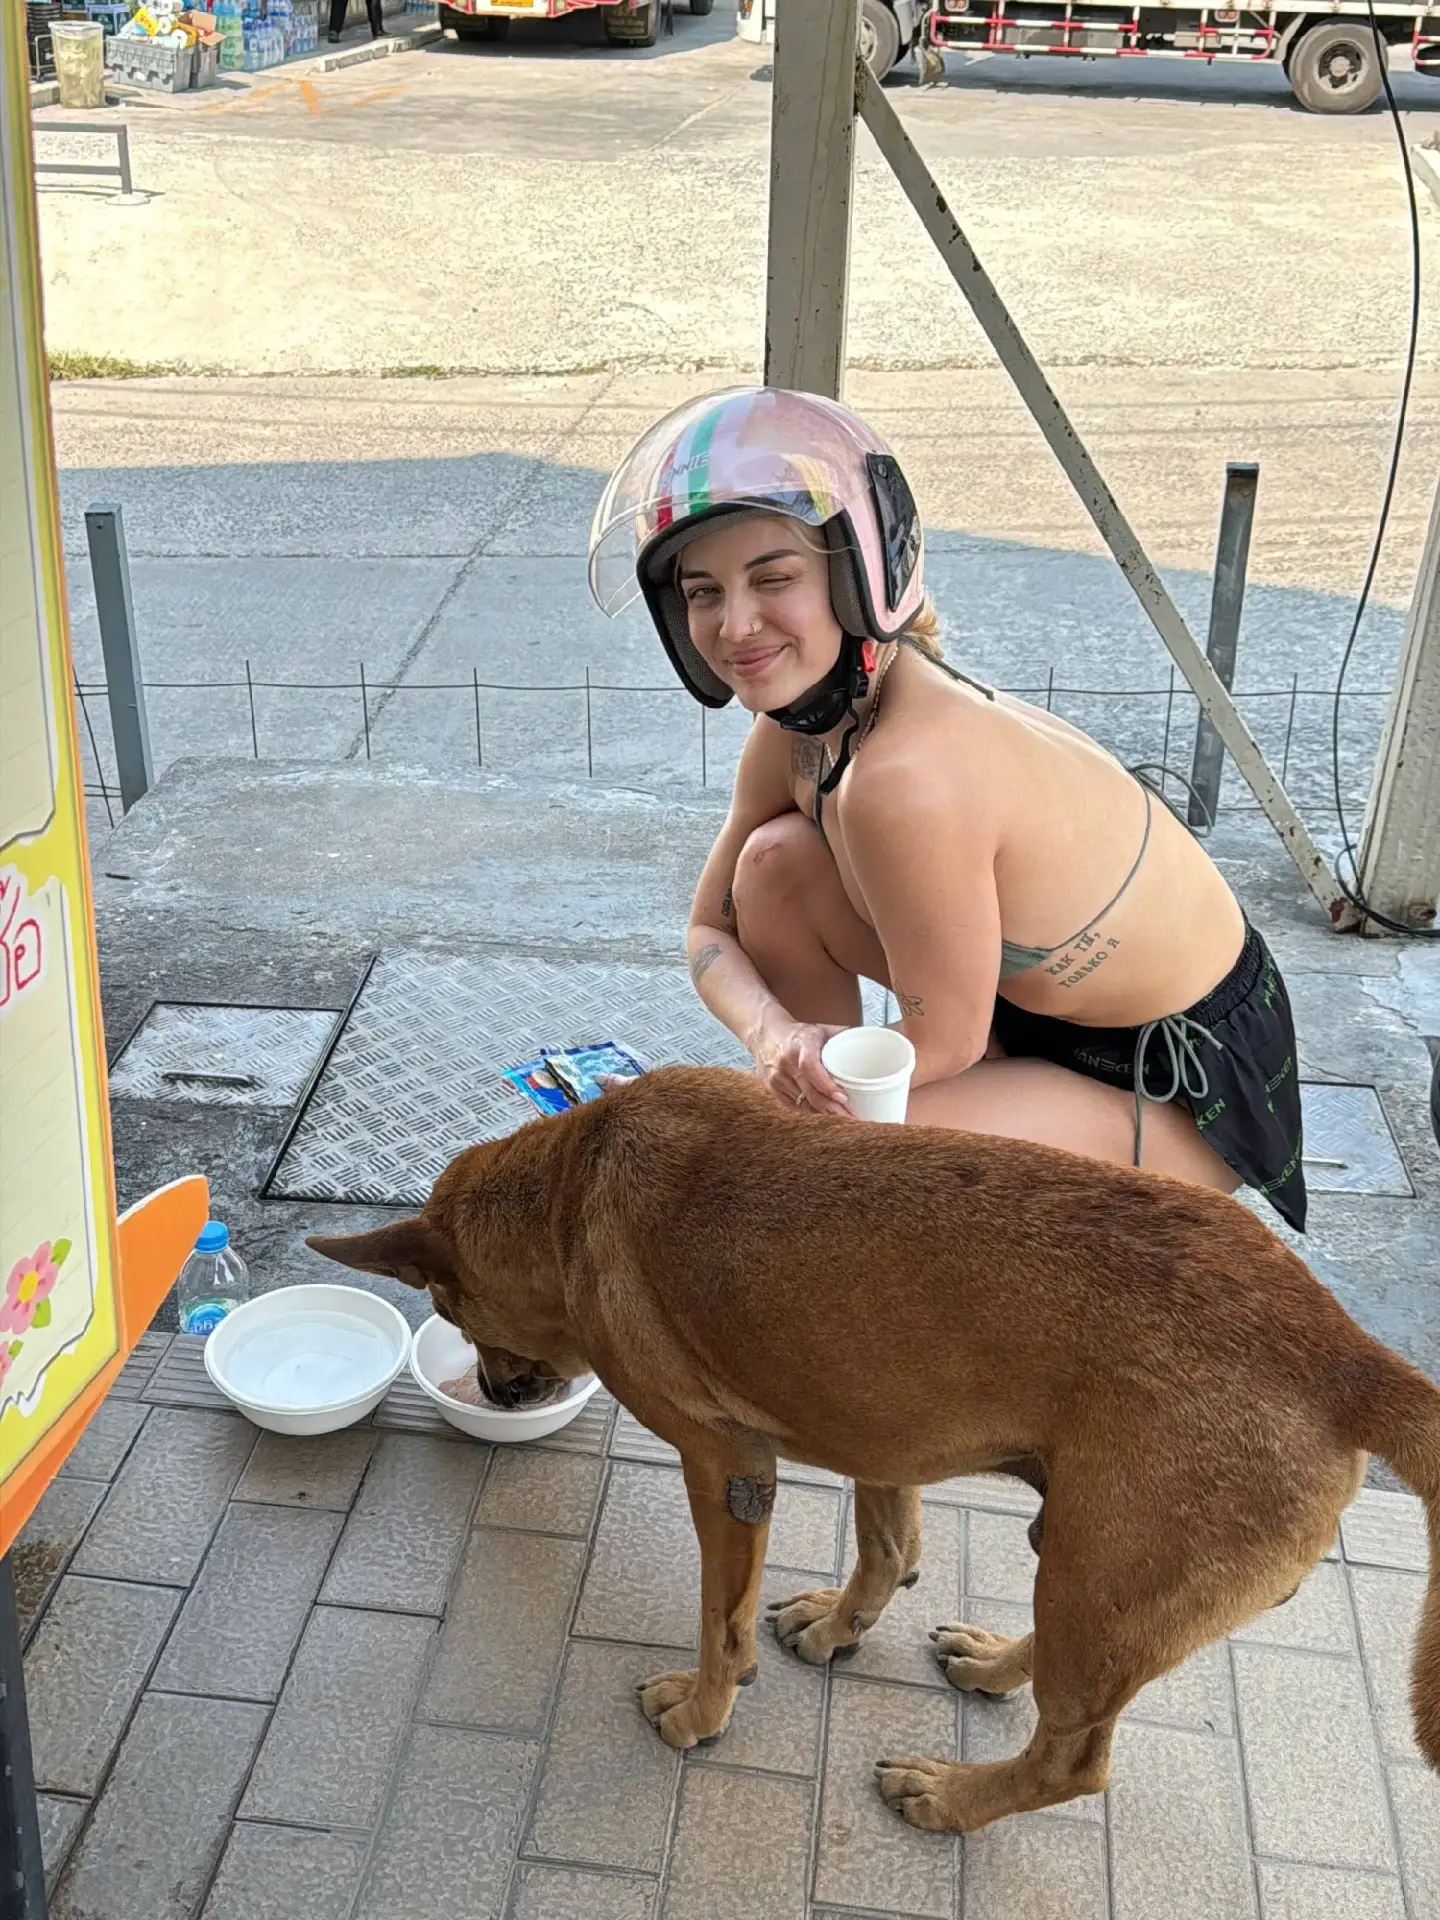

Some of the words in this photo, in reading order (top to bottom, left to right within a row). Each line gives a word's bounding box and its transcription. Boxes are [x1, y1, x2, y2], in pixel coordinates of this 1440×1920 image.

[1044, 952, 1076, 975] КАК
[1057, 951, 1108, 988] ТОЛЬКО
[1107, 937, 1121, 949] Я
